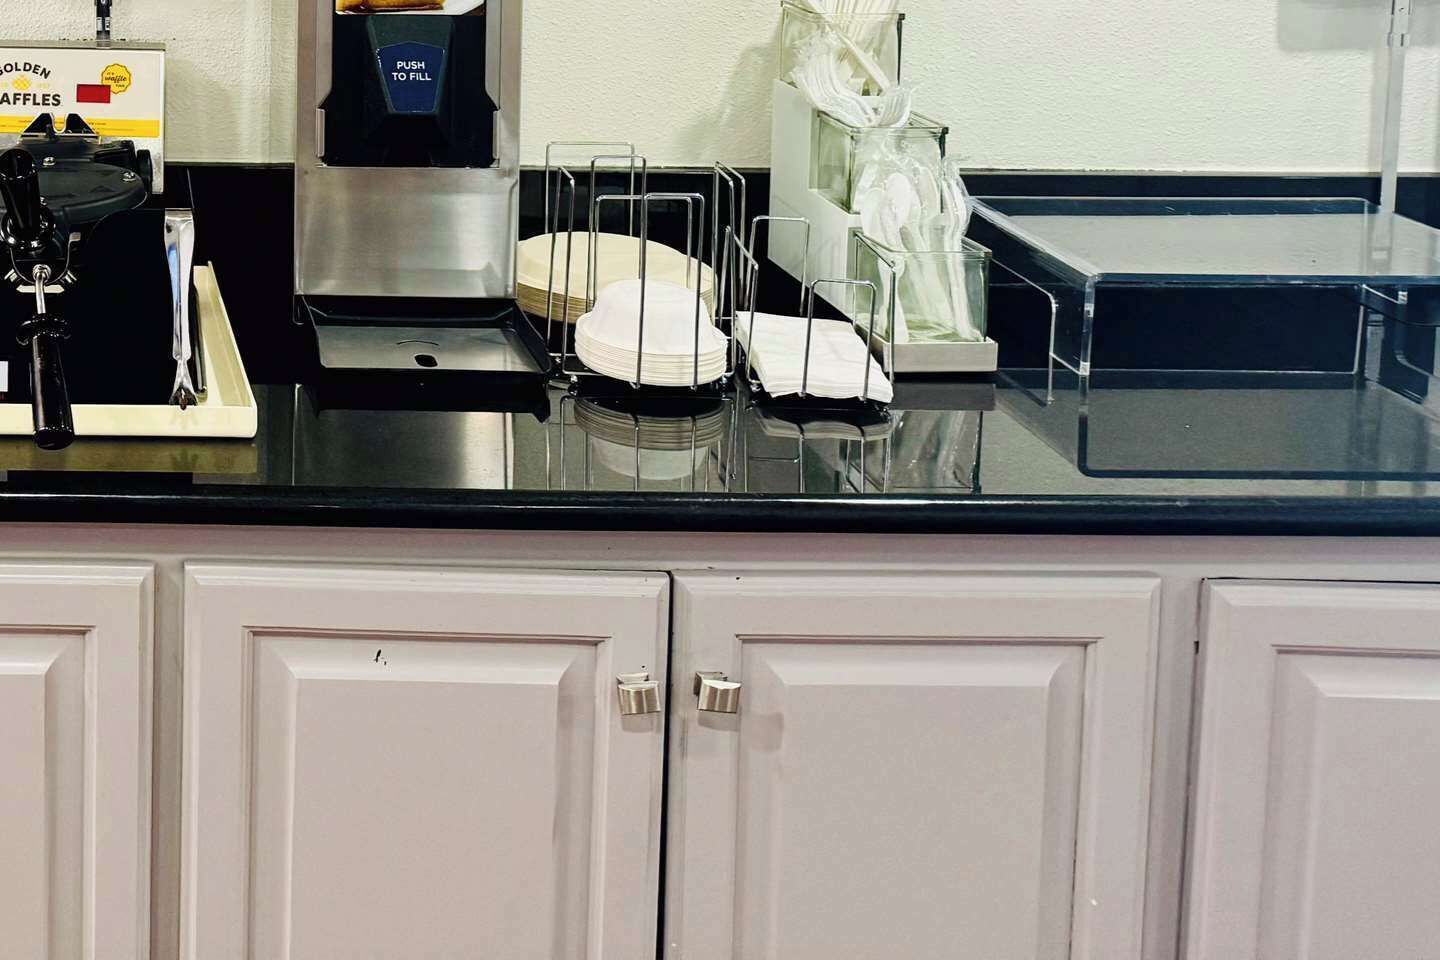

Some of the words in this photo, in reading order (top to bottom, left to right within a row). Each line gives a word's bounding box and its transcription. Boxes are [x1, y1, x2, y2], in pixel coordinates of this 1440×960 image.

[396, 60, 426, 70] PUSH
[391, 72, 407, 81] TO
[409, 72, 432, 81] FILL
